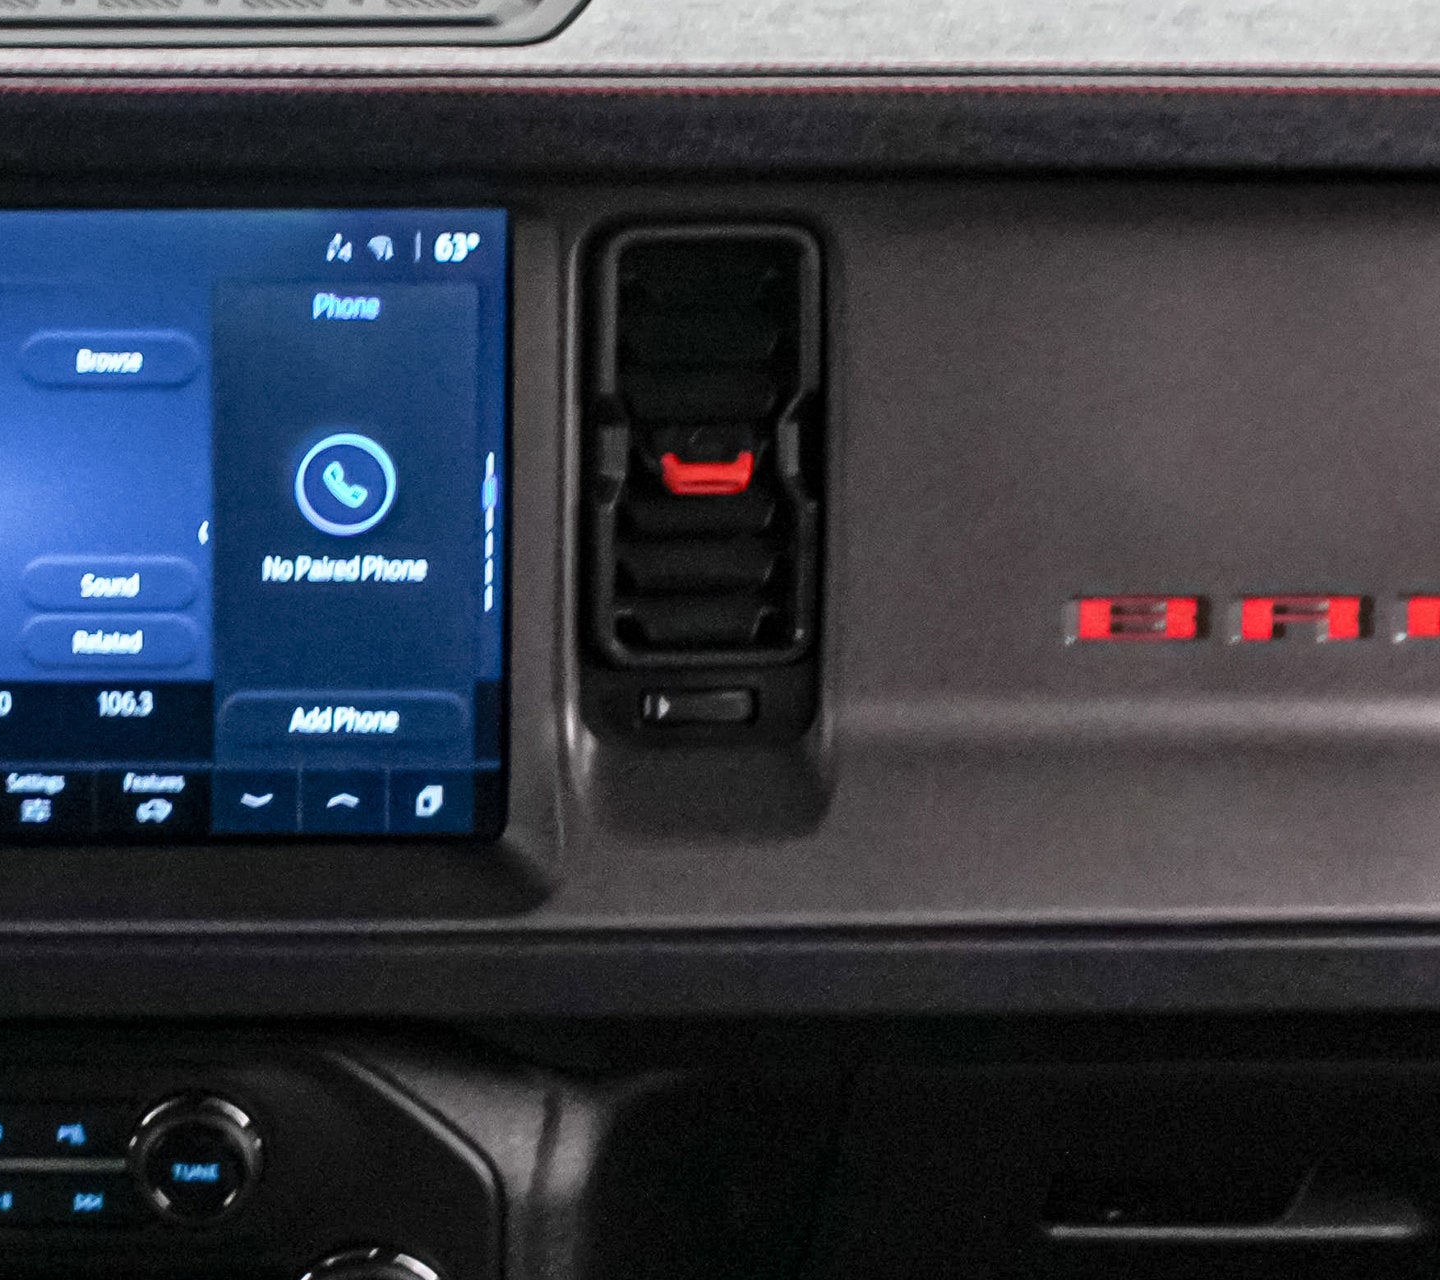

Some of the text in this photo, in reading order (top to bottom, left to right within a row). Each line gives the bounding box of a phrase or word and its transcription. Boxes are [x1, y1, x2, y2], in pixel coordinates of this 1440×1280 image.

[433, 231, 481, 263] 63°
[312, 292, 382, 321] Phone
[75, 348, 144, 374] Browse
[261, 554, 429, 583] No Paired Phone
[80, 572, 140, 599] Sound
[71, 629, 144, 655] Related
[96, 690, 154, 717] 106.3
[287, 705, 400, 734] Add Phone
[5, 772, 66, 795] Settings
[122, 771, 186, 793] Features
[172, 1162, 220, 1182] TUNE
